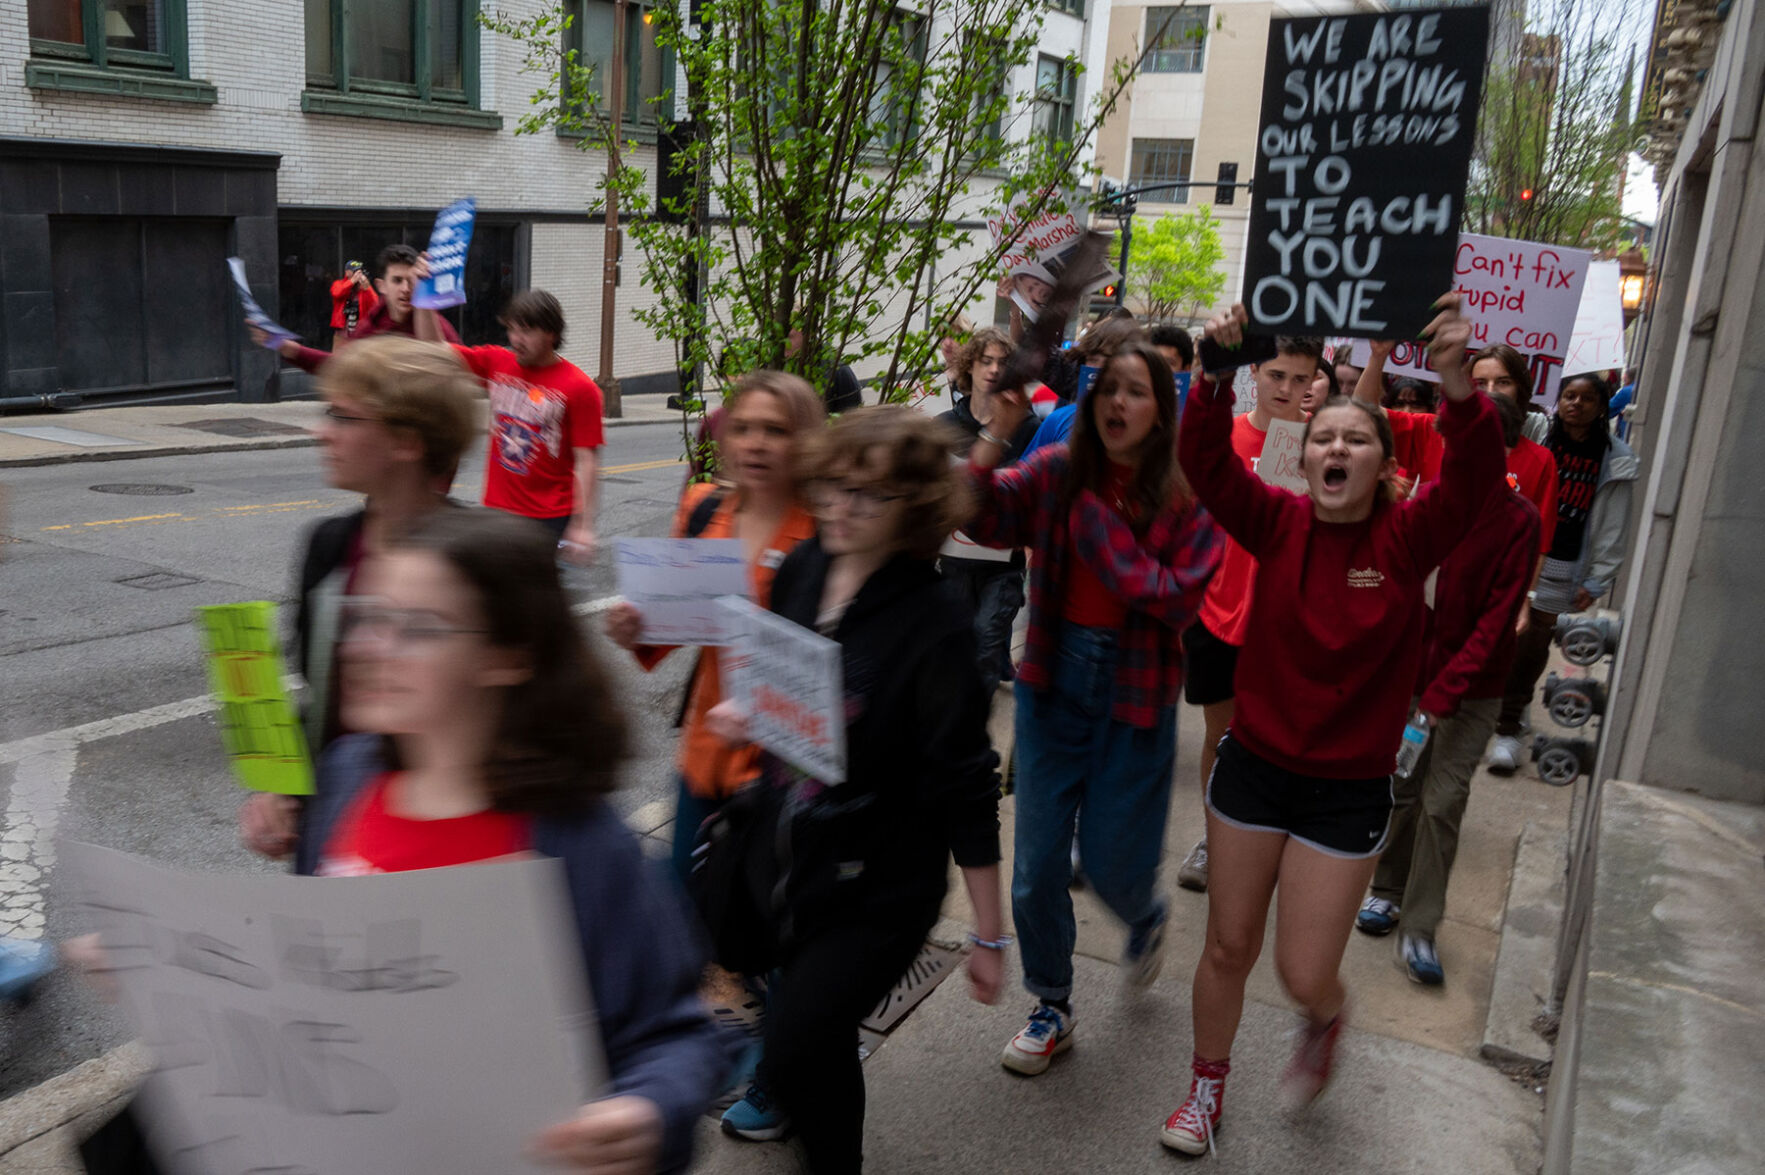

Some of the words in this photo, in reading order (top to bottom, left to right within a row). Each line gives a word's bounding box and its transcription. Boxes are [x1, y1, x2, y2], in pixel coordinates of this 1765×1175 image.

[1284, 17, 1348, 65] WE
[1366, 12, 1443, 61] ARE
[1283, 57, 1466, 122] SKIPPING
[1261, 122, 1318, 157] OUR
[1331, 113, 1460, 151] LESSONS
[1268, 155, 1350, 198] TO
[1266, 193, 1451, 236] TEACH
[1267, 229, 1382, 278] YOU
[1454, 243, 1524, 280] Can't
[1532, 250, 1575, 289] fix
[1252, 275, 1388, 331] ONE
[1505, 326, 1558, 351] can
